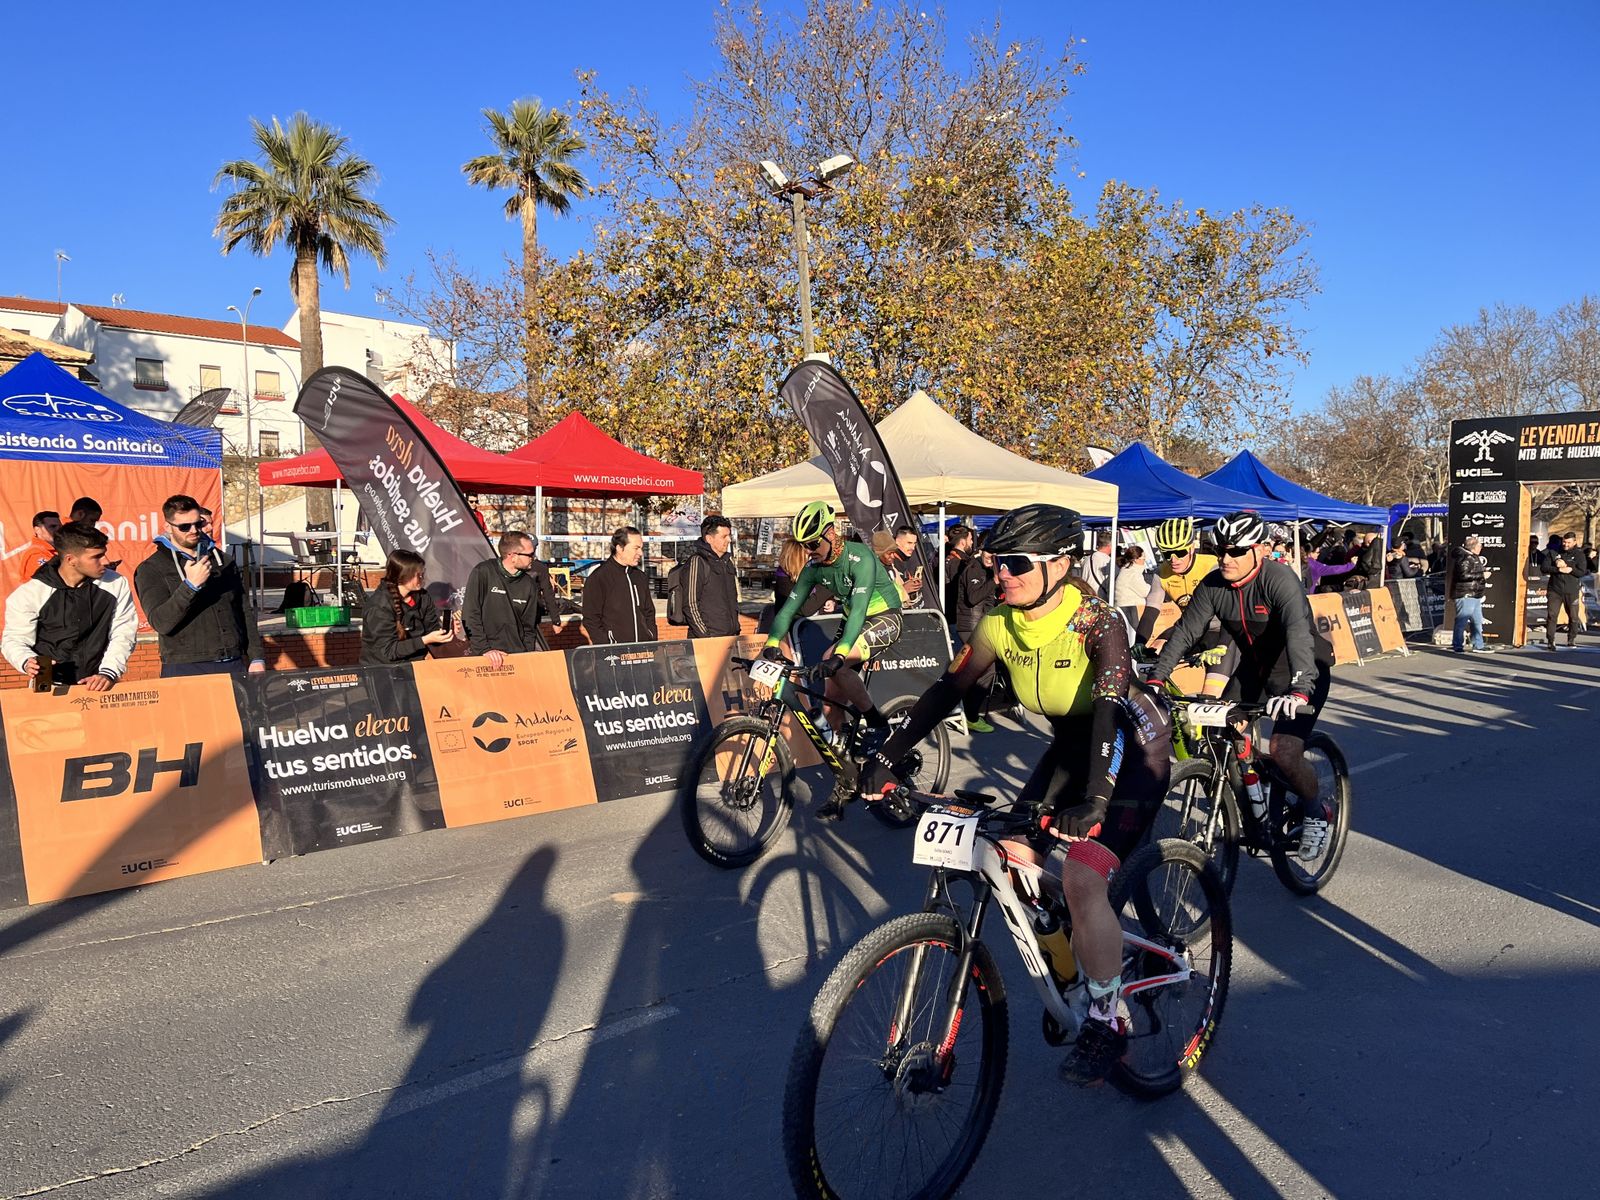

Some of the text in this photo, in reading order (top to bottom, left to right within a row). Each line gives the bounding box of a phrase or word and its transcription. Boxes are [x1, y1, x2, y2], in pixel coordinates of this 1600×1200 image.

[83, 434, 164, 454] Sanitaria
[1518, 448, 1537, 460] MTB
[1540, 447, 1564, 460] RACE
[574, 473, 675, 488] www.masquebici.com
[1461, 468, 1480, 477] UCI
[756, 661, 778, 676] 757
[882, 659, 898, 670] tus
[899, 656, 939, 669] sentidos.
[585, 685, 693, 713] Huelva eleva
[514, 709, 575, 729] Andalucía
[594, 710, 700, 736] tus sentidos.
[258, 713, 410, 750] Huelva eleva
[796, 711, 844, 770] SCOTT
[517, 738, 539, 747] SPORT
[605, 733, 693, 752] www.turismohuelva.org
[264, 743, 418, 780] tus sentidos.
[60, 741, 204, 803] BH
[649, 776, 663, 786] UCI
[280, 770, 407, 797] www.turismohuelva.org
[508, 798, 524, 808] UCI
[340, 824, 362, 836] UCI
[923, 820, 966, 847] 871
[127, 861, 153, 873] UCI
